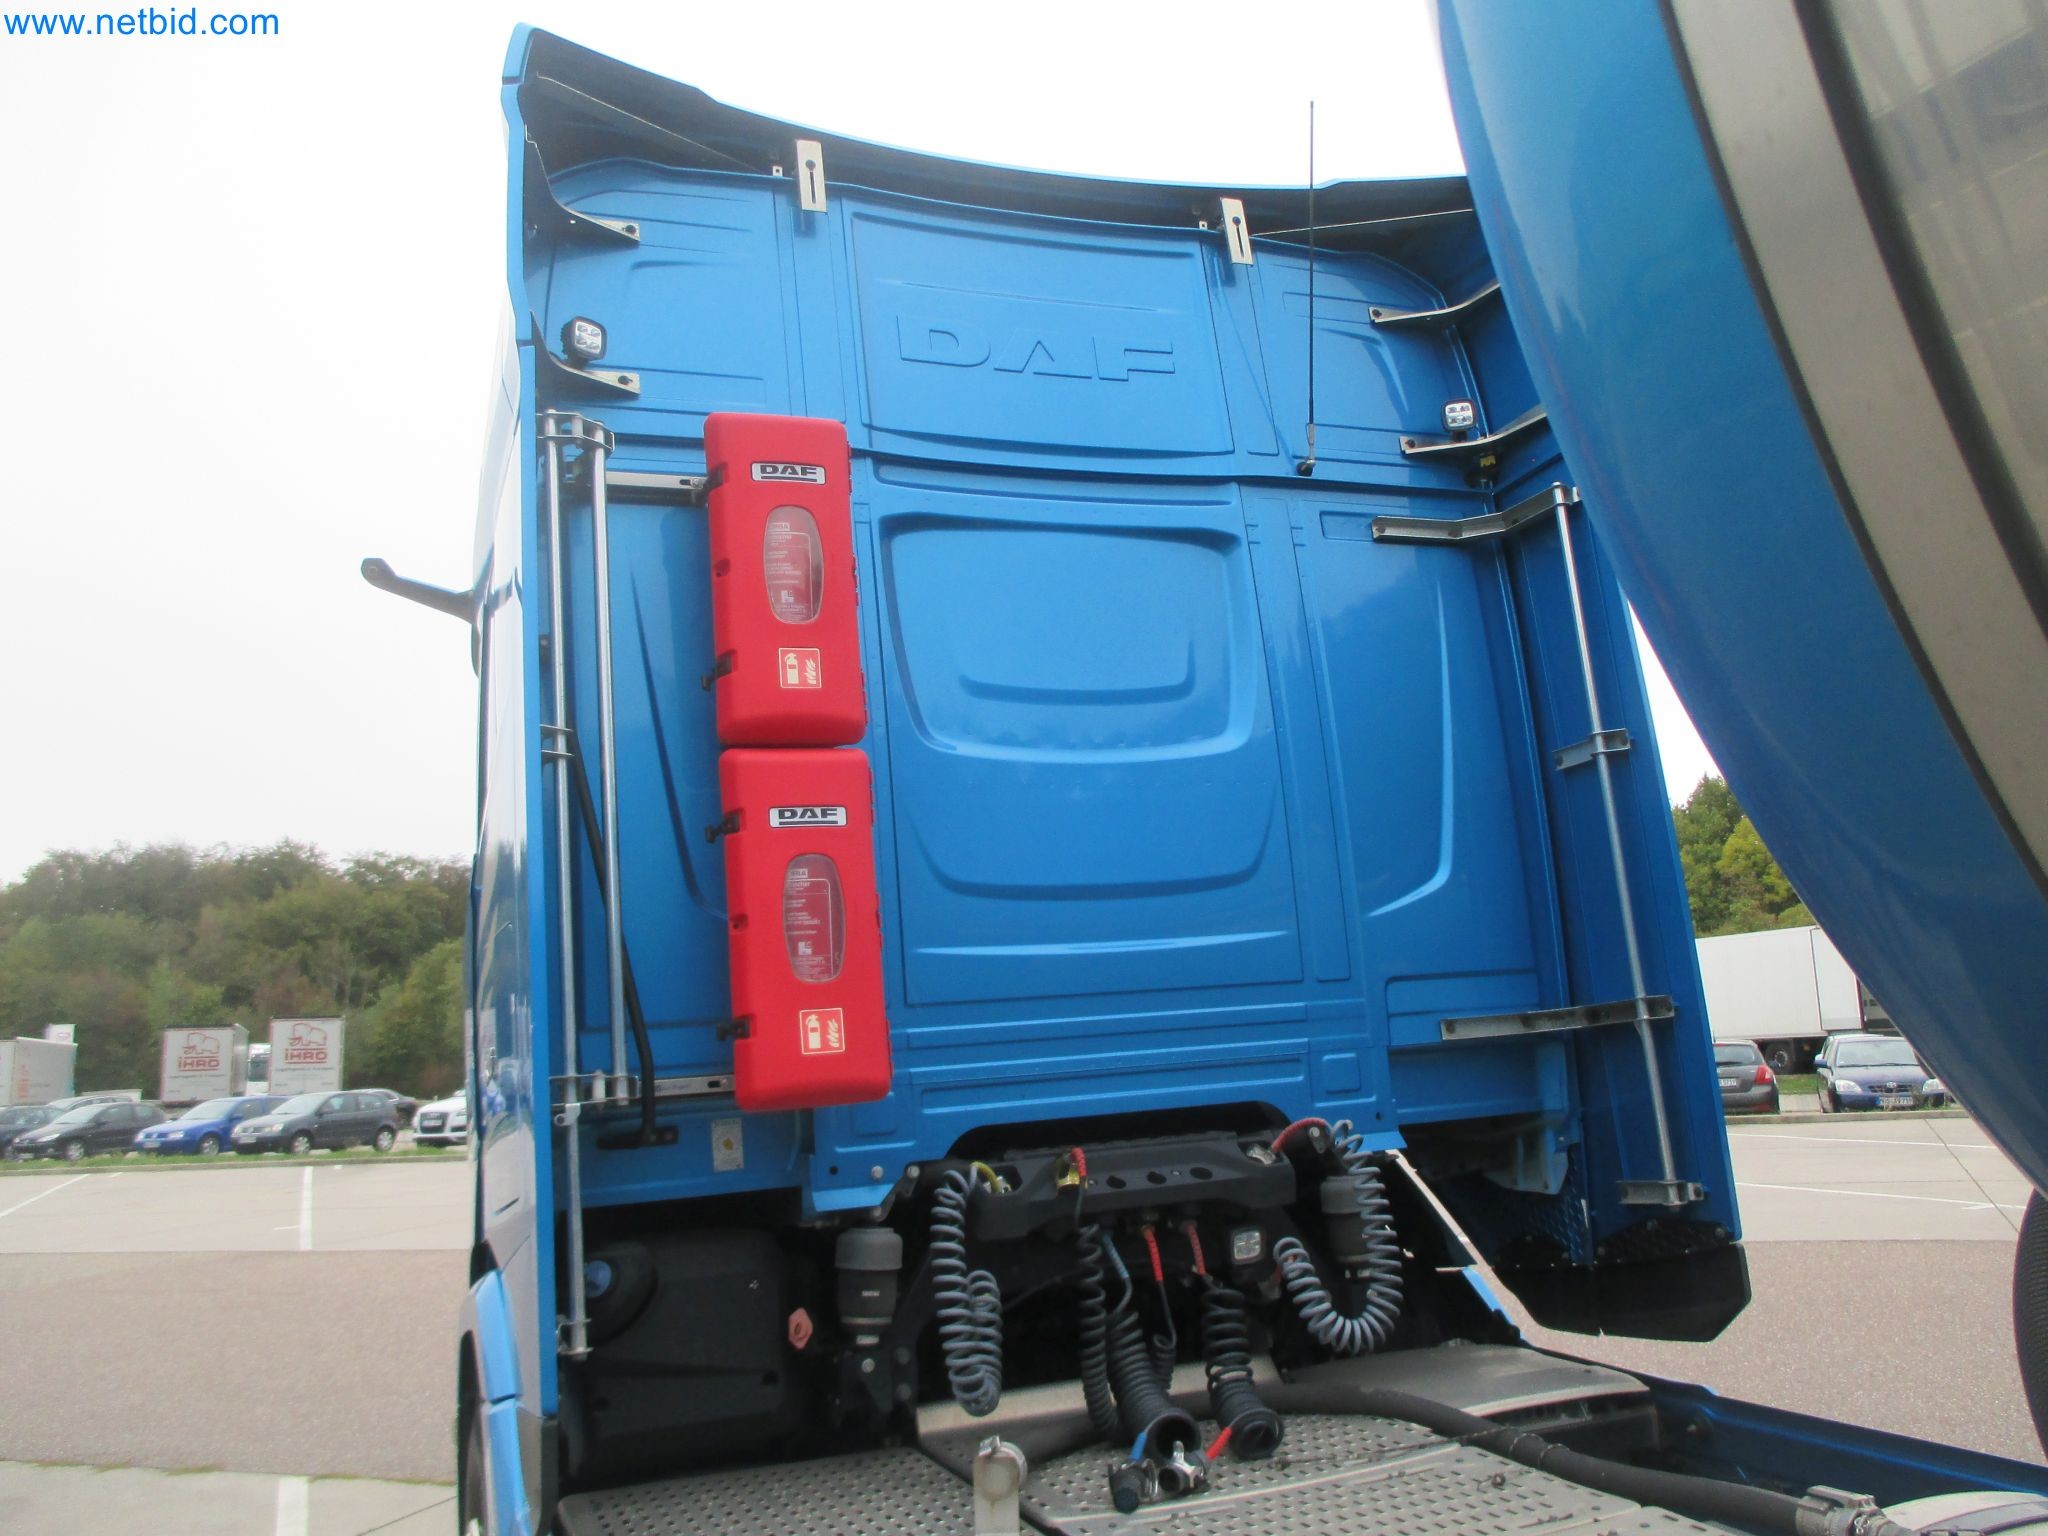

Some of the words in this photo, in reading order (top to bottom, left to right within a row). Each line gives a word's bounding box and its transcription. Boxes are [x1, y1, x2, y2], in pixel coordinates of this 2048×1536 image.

[896, 313, 1175, 382] DAF
[760, 464, 817, 476] DAF
[778, 807, 838, 819] DAF
